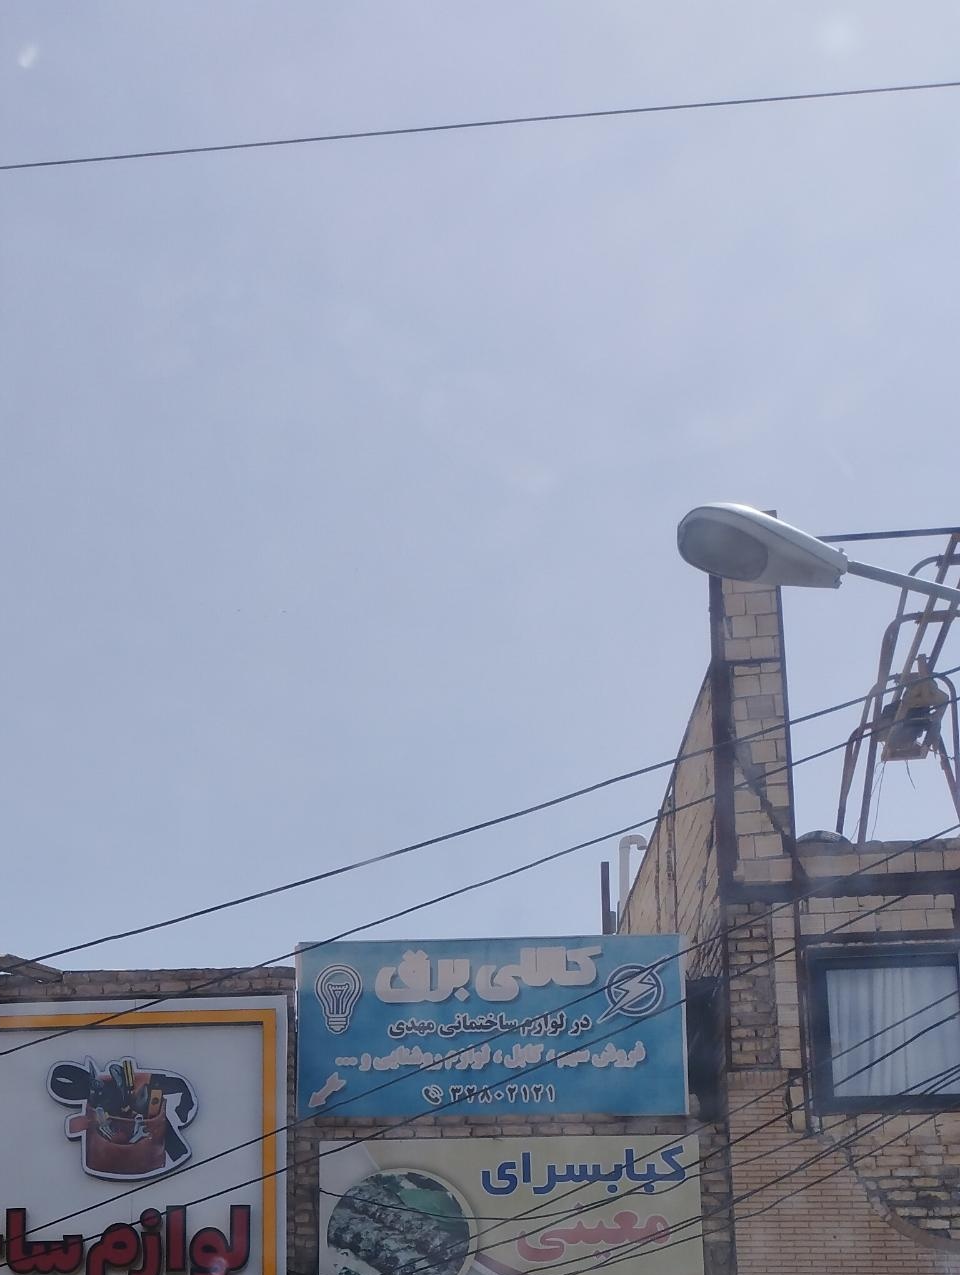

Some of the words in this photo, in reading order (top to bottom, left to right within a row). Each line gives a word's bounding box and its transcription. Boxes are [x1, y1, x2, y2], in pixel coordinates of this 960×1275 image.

[375, 949, 471, 1003] برق
[388, 1018, 436, 1039] مهدی
[438, 1012, 518, 1038] ساختمانی
[519, 1010, 567, 1037] لوازم
[568, 1013, 592, 1036] در
[449, 1083, 556, 1105] ۳۲۸۰۲۱۲۱
[516, 1202, 672, 1263] معینی
